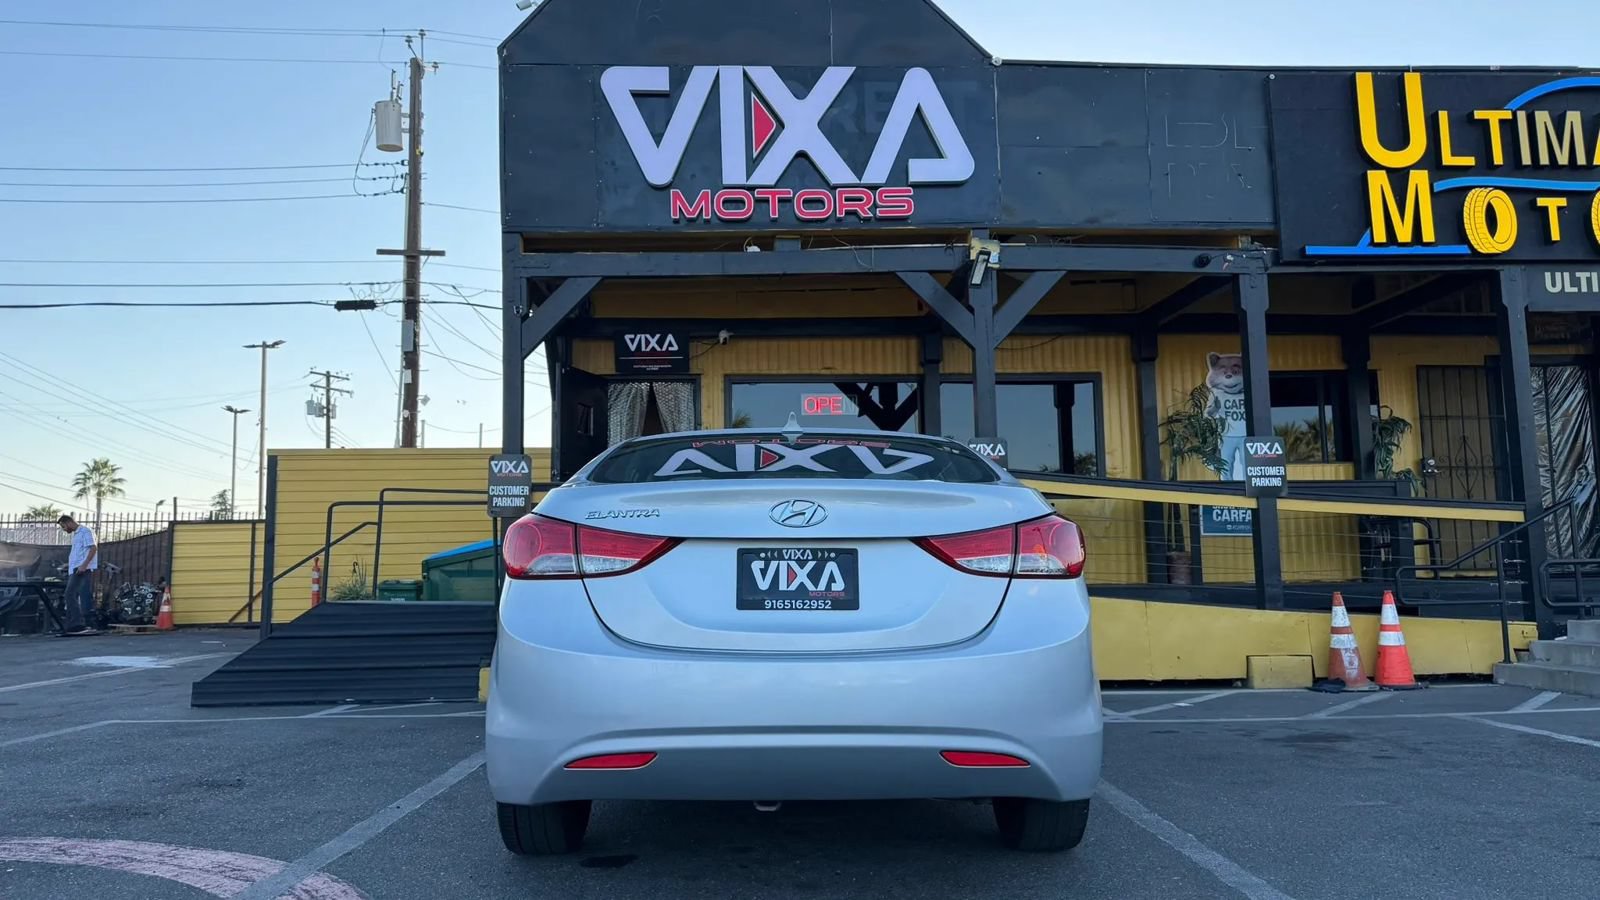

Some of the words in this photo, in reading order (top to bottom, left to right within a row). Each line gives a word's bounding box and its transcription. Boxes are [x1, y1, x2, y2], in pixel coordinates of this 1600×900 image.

[601, 65, 975, 186] VIXA
[1356, 72, 1600, 168] ULTIM
[669, 186, 915, 220] MOTORS
[1367, 169, 1600, 254] MOT
[1544, 271, 1599, 293] ULTI
[624, 333, 679, 352] VIXA
[1224, 411, 1247, 422] FOX
[1246, 442, 1283, 455] VIXA
[490, 460, 529, 473] VIXA
[1247, 466, 1285, 476] CUSTOMER
[1252, 477, 1282, 487] PARKING
[489, 485, 529, 496] CUSTOMER
[492, 496, 525, 507] PARKING
[585, 508, 660, 520] ELANTRA
[782, 549, 813, 560] VIXA
[750, 560, 845, 591] VIXA
[764, 600, 832, 609] 9165162952
